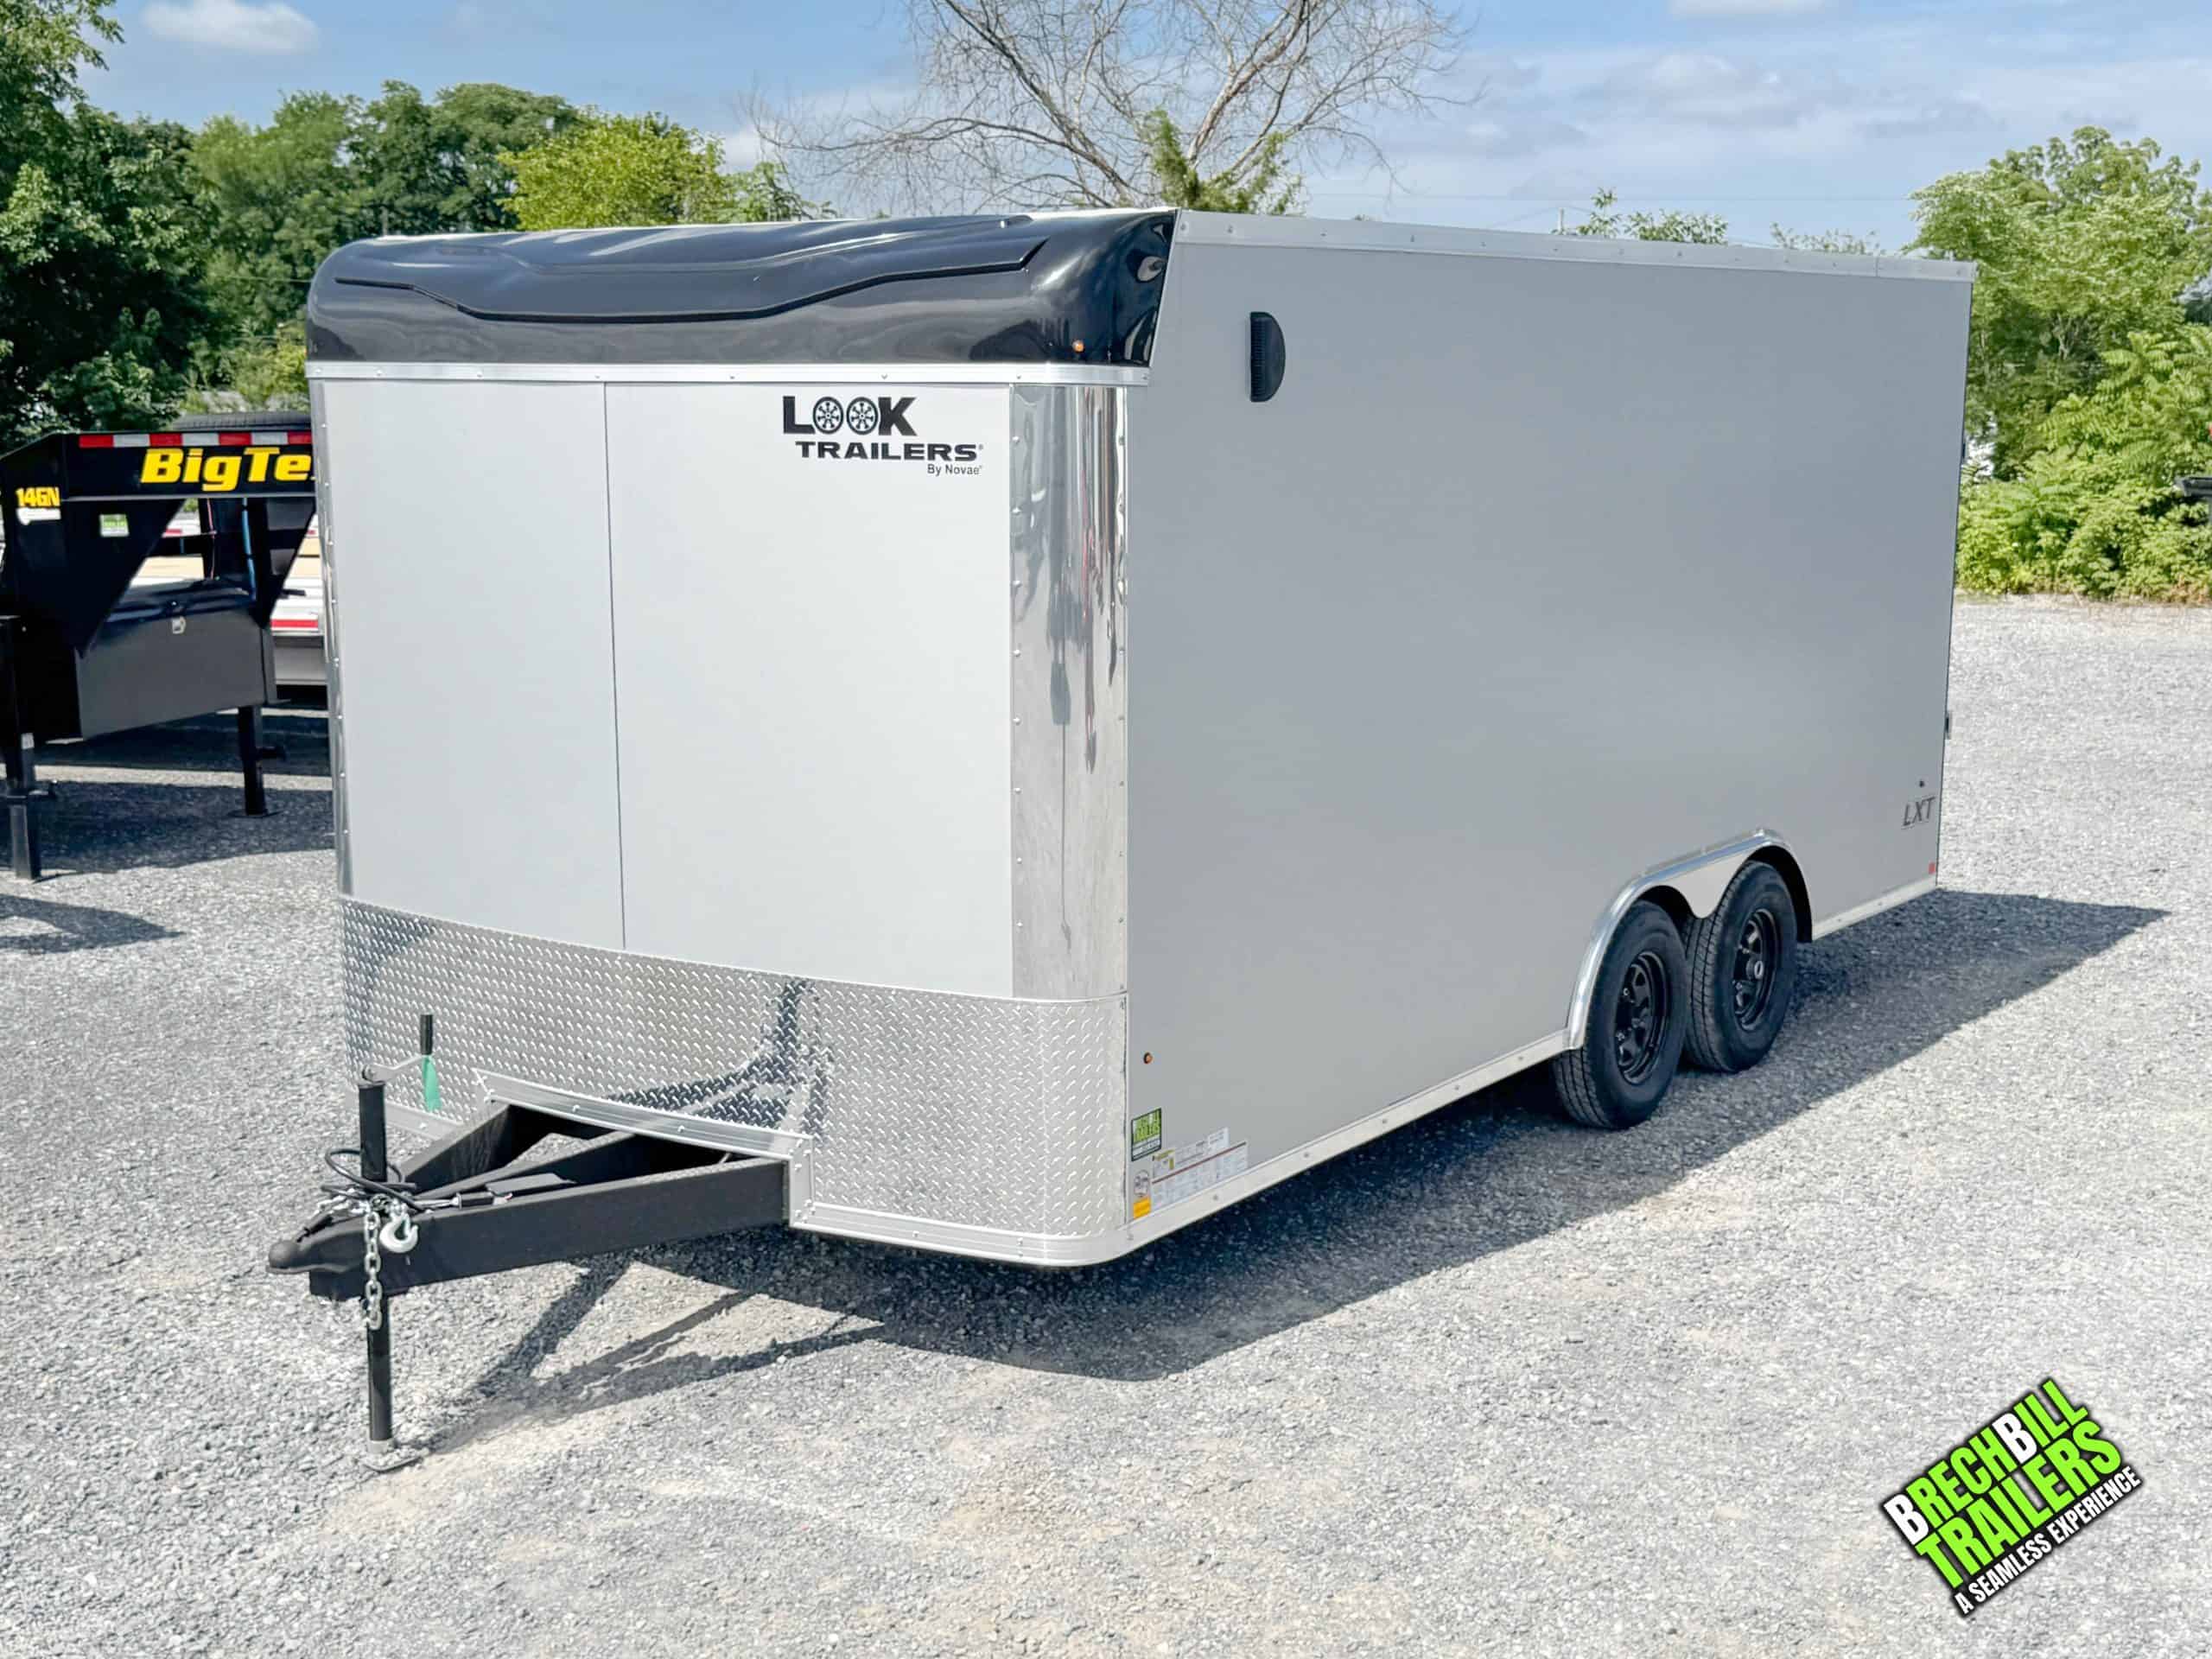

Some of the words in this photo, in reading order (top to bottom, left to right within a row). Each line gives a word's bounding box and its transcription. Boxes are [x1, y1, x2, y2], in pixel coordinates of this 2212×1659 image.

[783, 396, 918, 435] LOOK
[140, 448, 315, 492] BigTe
[927, 464, 941, 476] By
[1903, 797, 1936, 826] LXT
